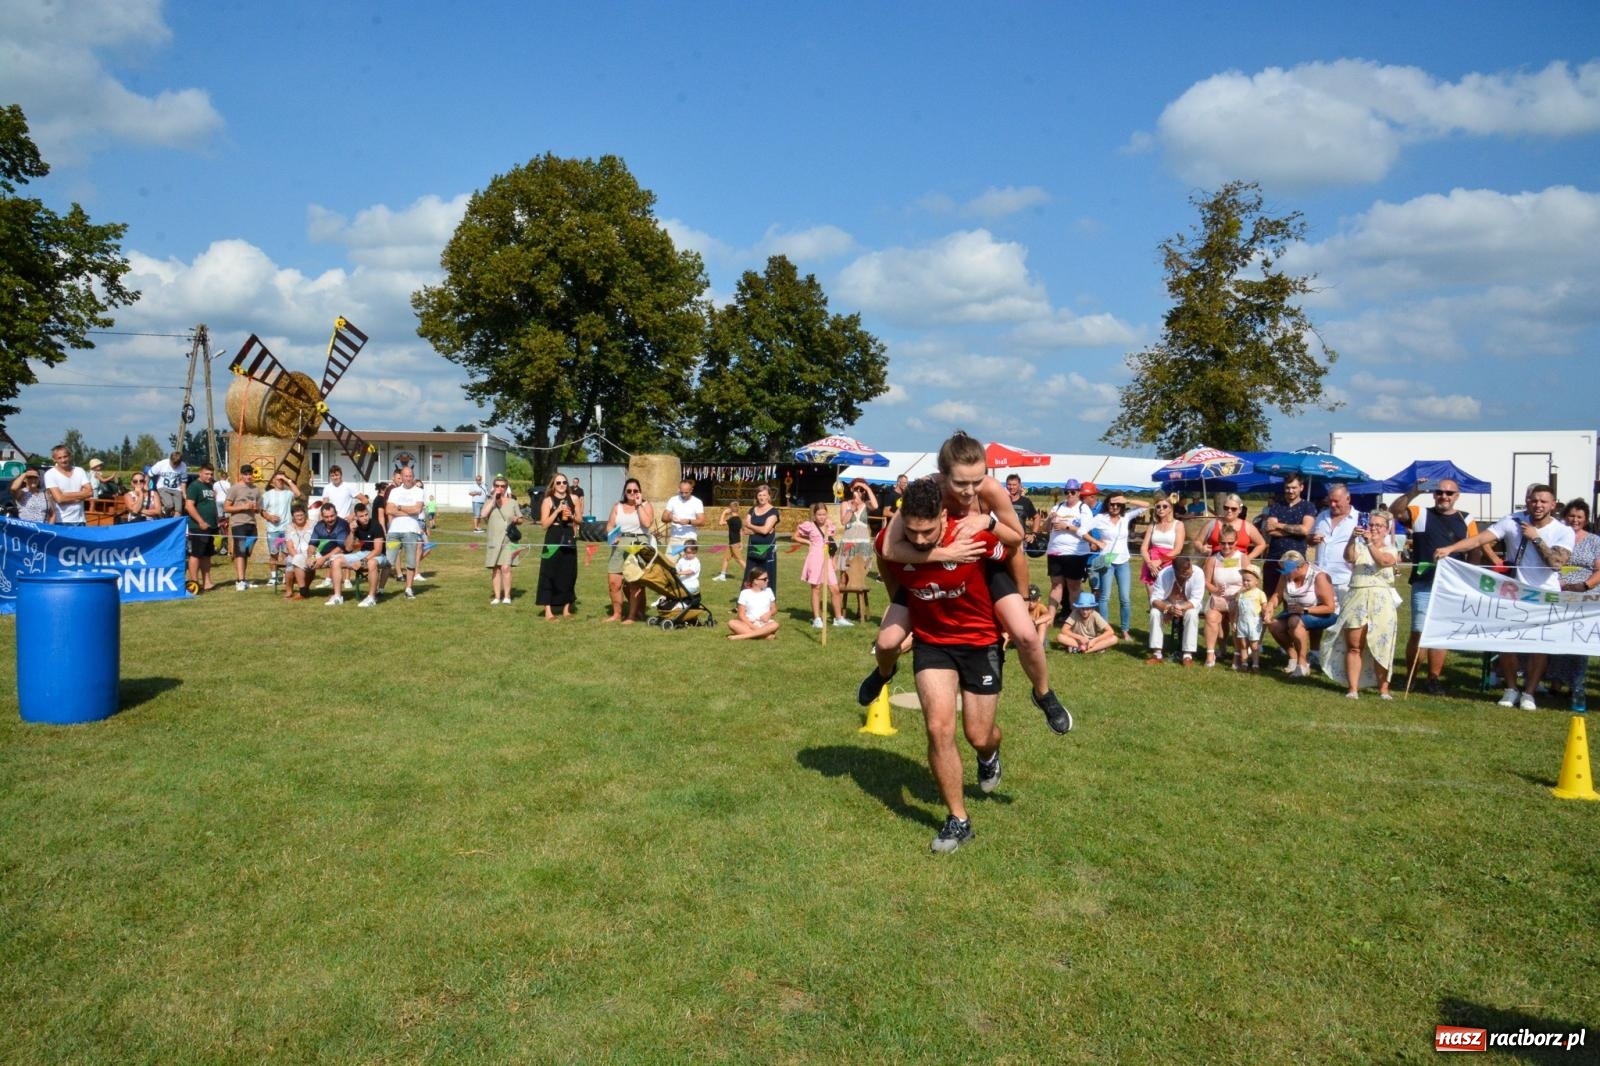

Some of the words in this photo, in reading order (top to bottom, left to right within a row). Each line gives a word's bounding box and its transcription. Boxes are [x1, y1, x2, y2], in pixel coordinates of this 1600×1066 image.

[58, 546, 146, 567] GMINA
[58, 567, 178, 593] NIK
[982, 675, 993, 685] 2
